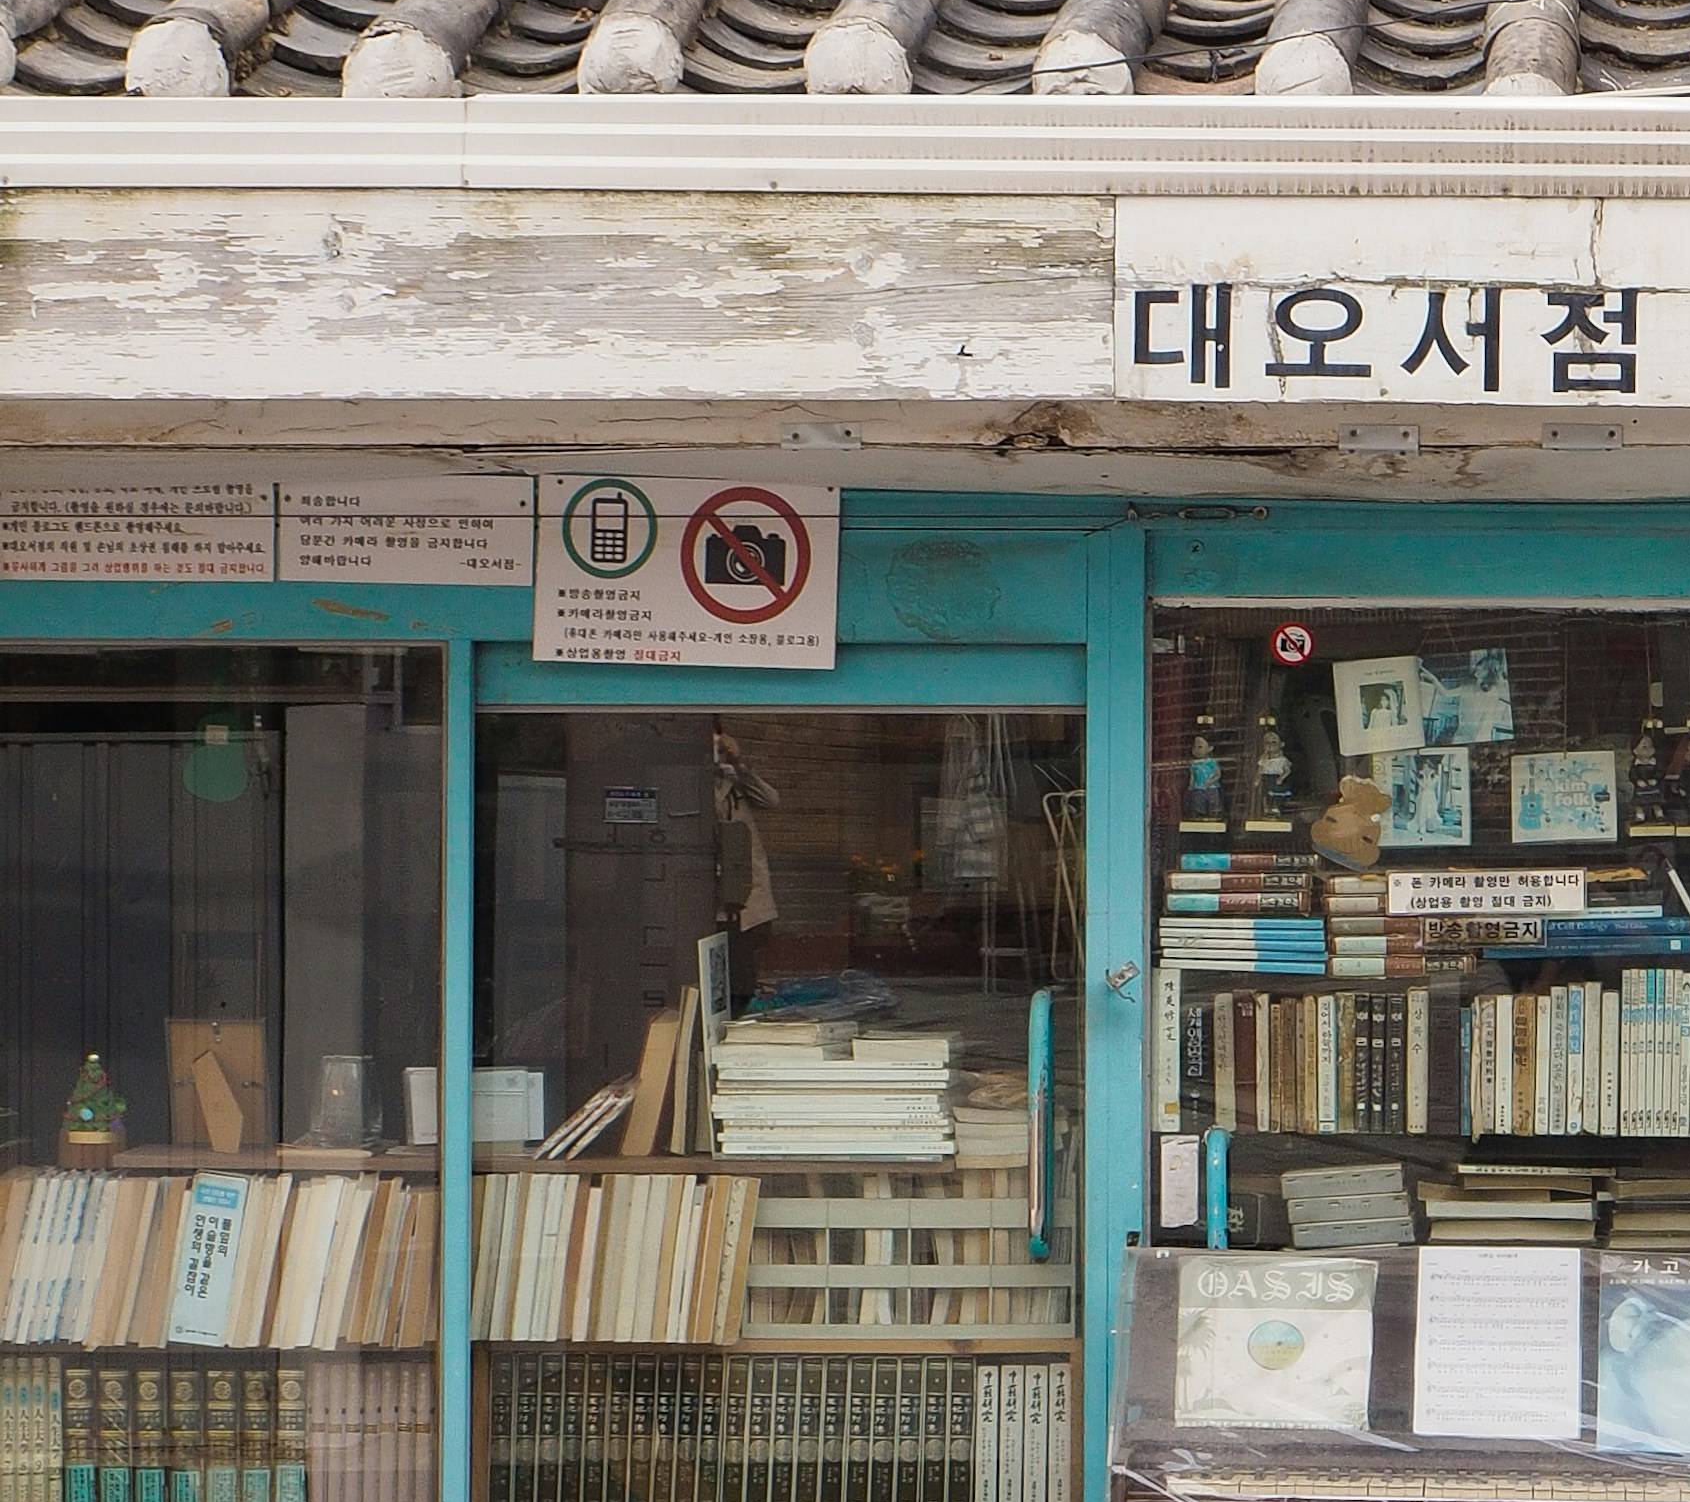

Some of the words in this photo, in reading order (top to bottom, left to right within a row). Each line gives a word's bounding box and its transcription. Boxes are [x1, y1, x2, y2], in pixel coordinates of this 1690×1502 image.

[1133, 283, 1639, 395] 대오서점
[301, 496, 361, 507] 죄송합니다
[343, 535, 378, 547] 카메라
[427, 537, 488, 549] 금지합니다
[1411, 878, 1423, 888] 폰
[1429, 877, 1467, 888] 카메라
[1474, 877, 1510, 887] 촬영만
[1518, 875, 1580, 887] 허용합니다
[1410, 898, 1453, 909] (상업용
[1460, 897, 1484, 908] 촬영
[1492, 896, 1516, 907] 절대
[1522, 895, 1552, 907] 금지)
[1428, 921, 1539, 940] 방송촬영금지
[1198, 1269, 1354, 1302] OASIS
